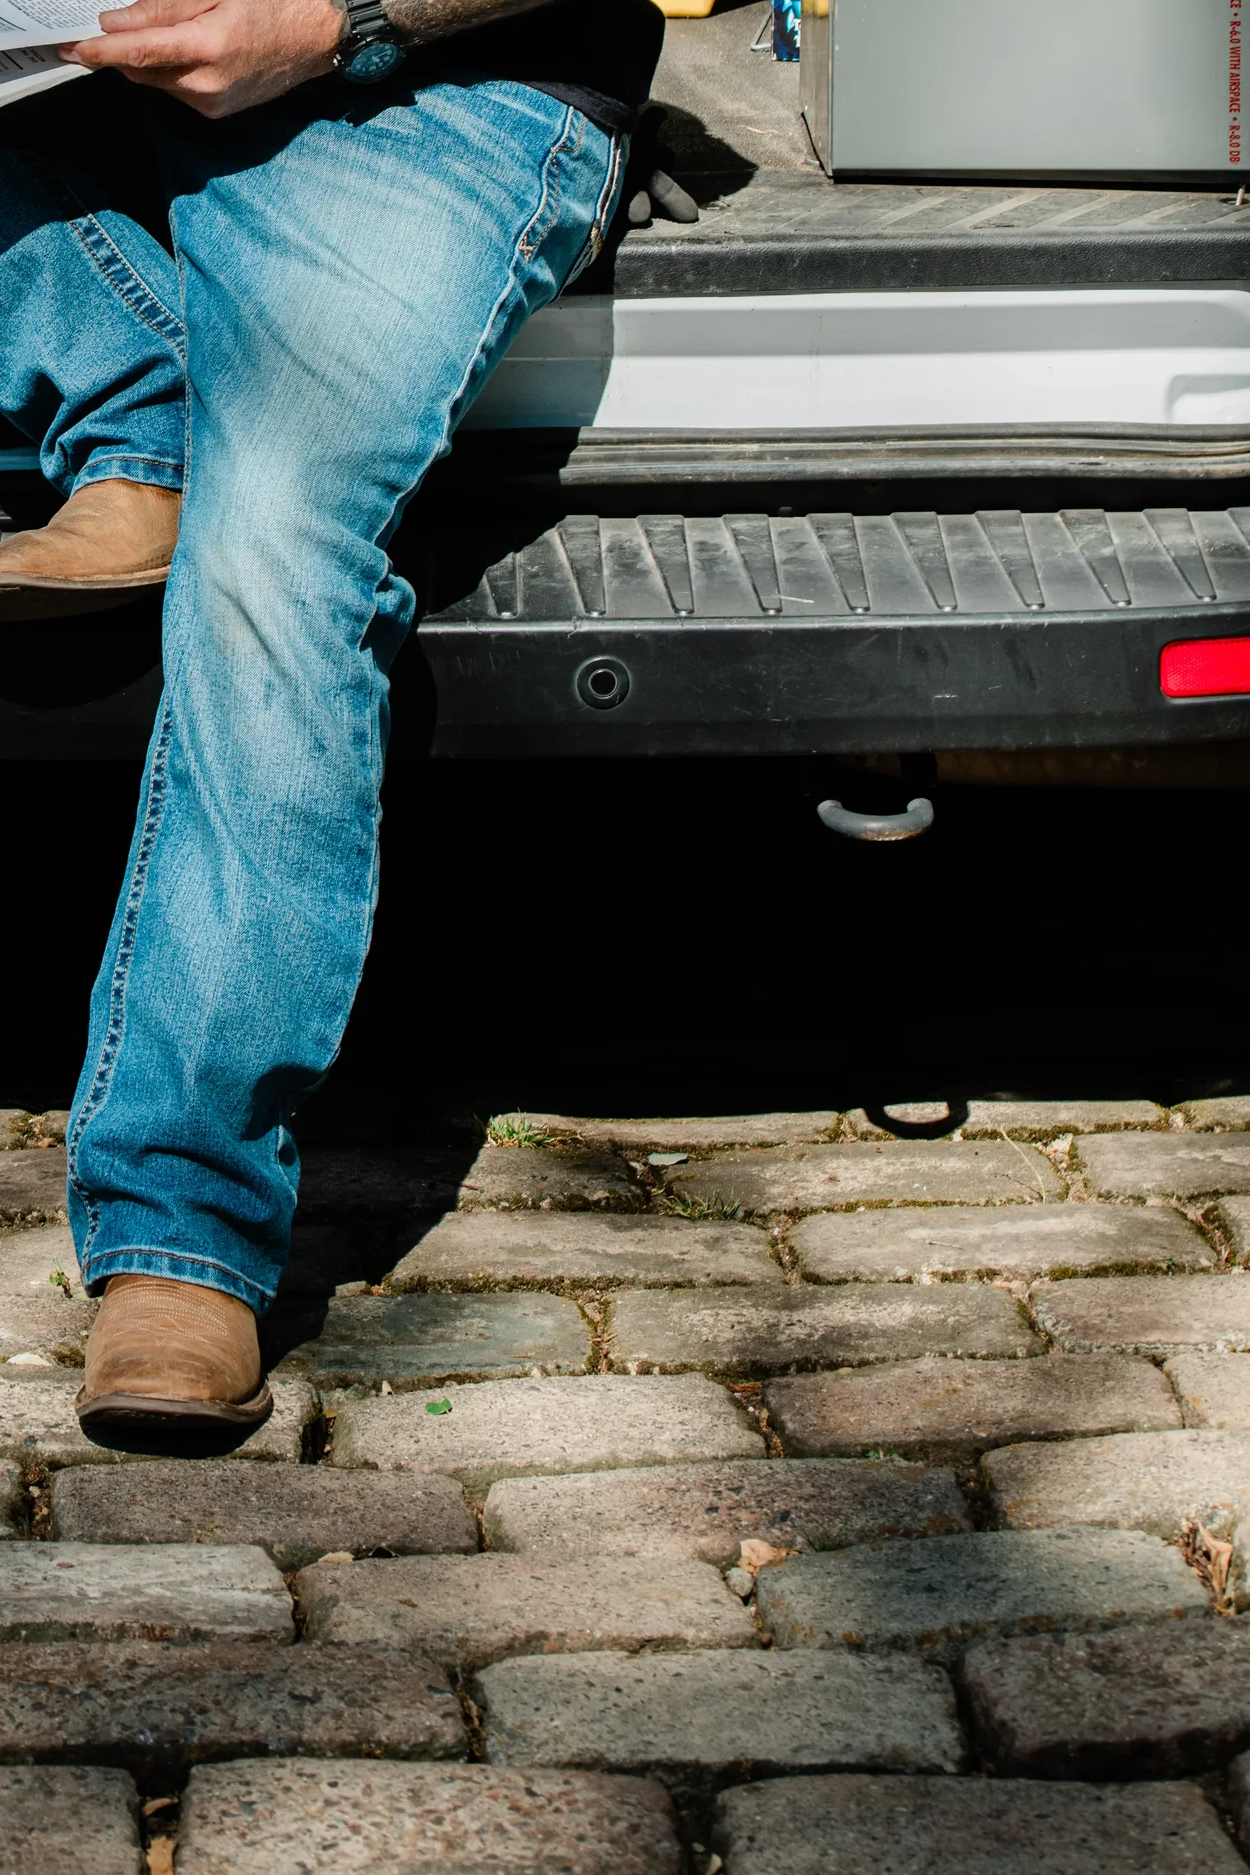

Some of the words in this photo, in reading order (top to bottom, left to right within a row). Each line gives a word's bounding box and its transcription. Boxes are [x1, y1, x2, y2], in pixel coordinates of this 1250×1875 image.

[1229, 21, 1242, 44] R-6.0
[1229, 47, 1241, 69] WITH
[1229, 72, 1240, 113] AIRSPACE
[1228, 125, 1240, 148] R-8.0
[1229, 151, 1240, 164] DB
